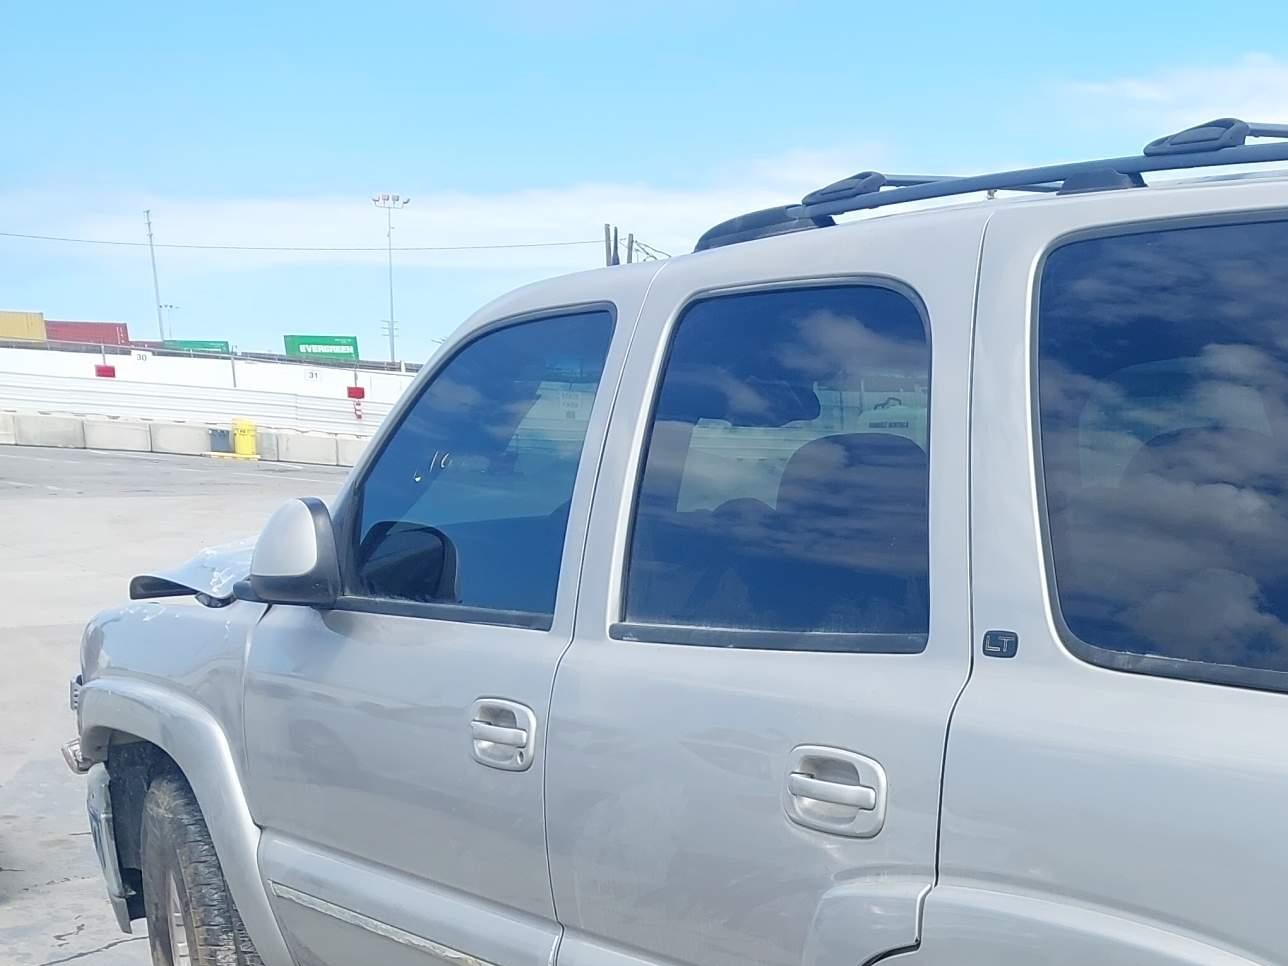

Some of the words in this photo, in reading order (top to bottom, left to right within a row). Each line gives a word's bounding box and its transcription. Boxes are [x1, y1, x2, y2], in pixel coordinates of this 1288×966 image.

[299, 344, 353, 353] EVERGREEN
[136, 353, 147, 361] 30
[307, 371, 319, 380] 31
[985, 635, 1016, 653] LT
